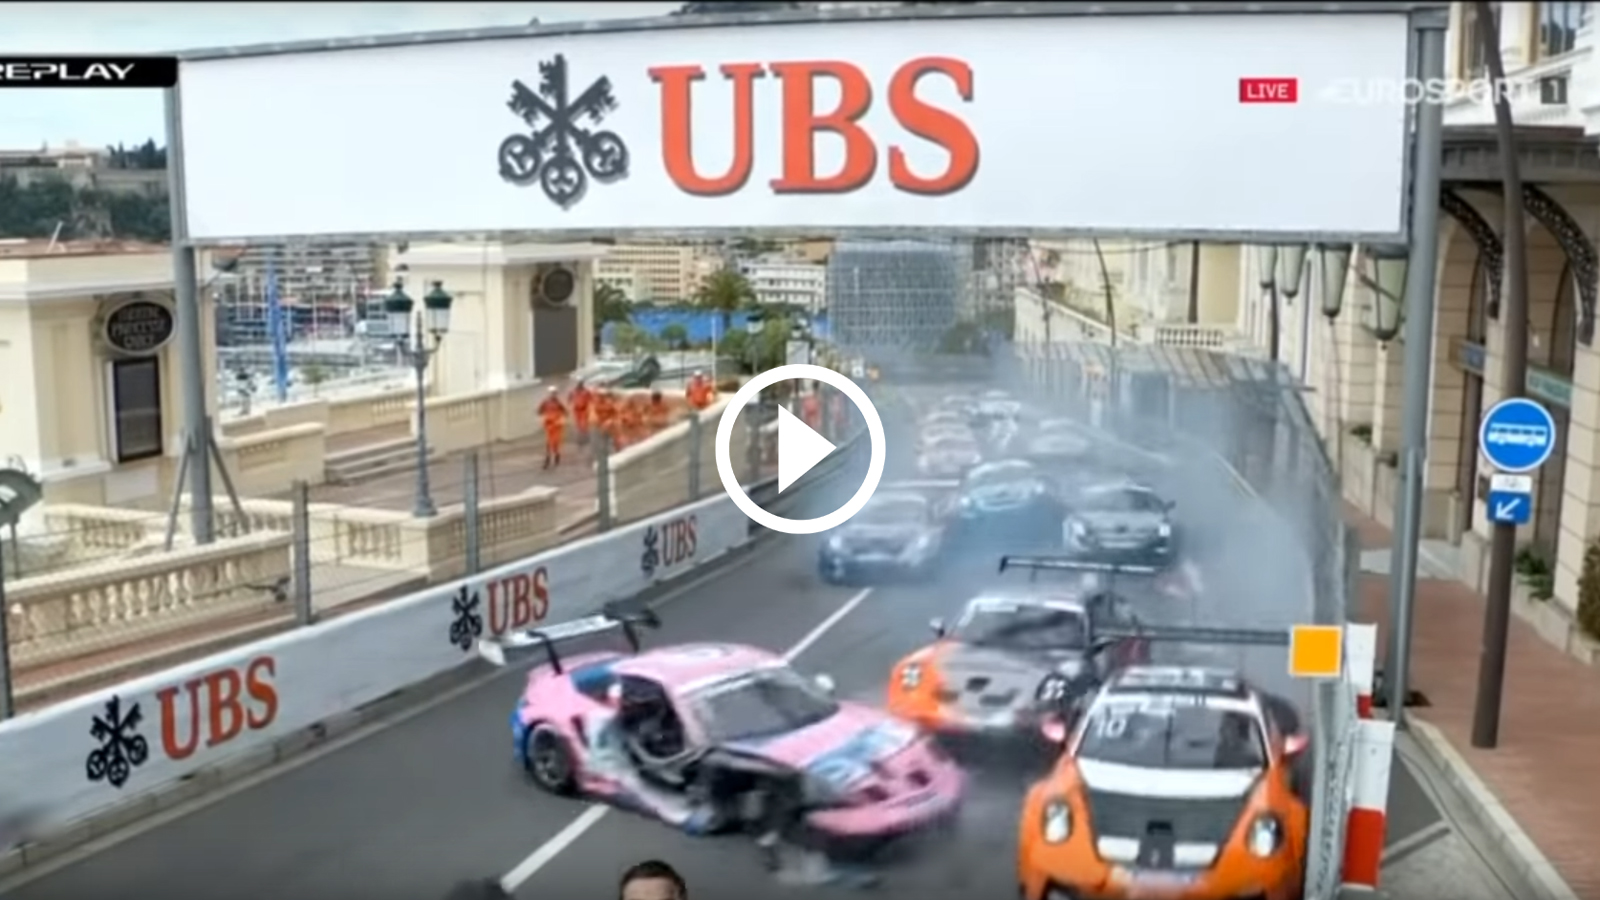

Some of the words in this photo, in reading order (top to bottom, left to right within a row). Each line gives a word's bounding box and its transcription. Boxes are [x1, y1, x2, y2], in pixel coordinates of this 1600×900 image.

[648, 57, 980, 197] UBS
[660, 516, 697, 567] UBS
[487, 566, 549, 636] UBS
[156, 656, 278, 760] UBS
